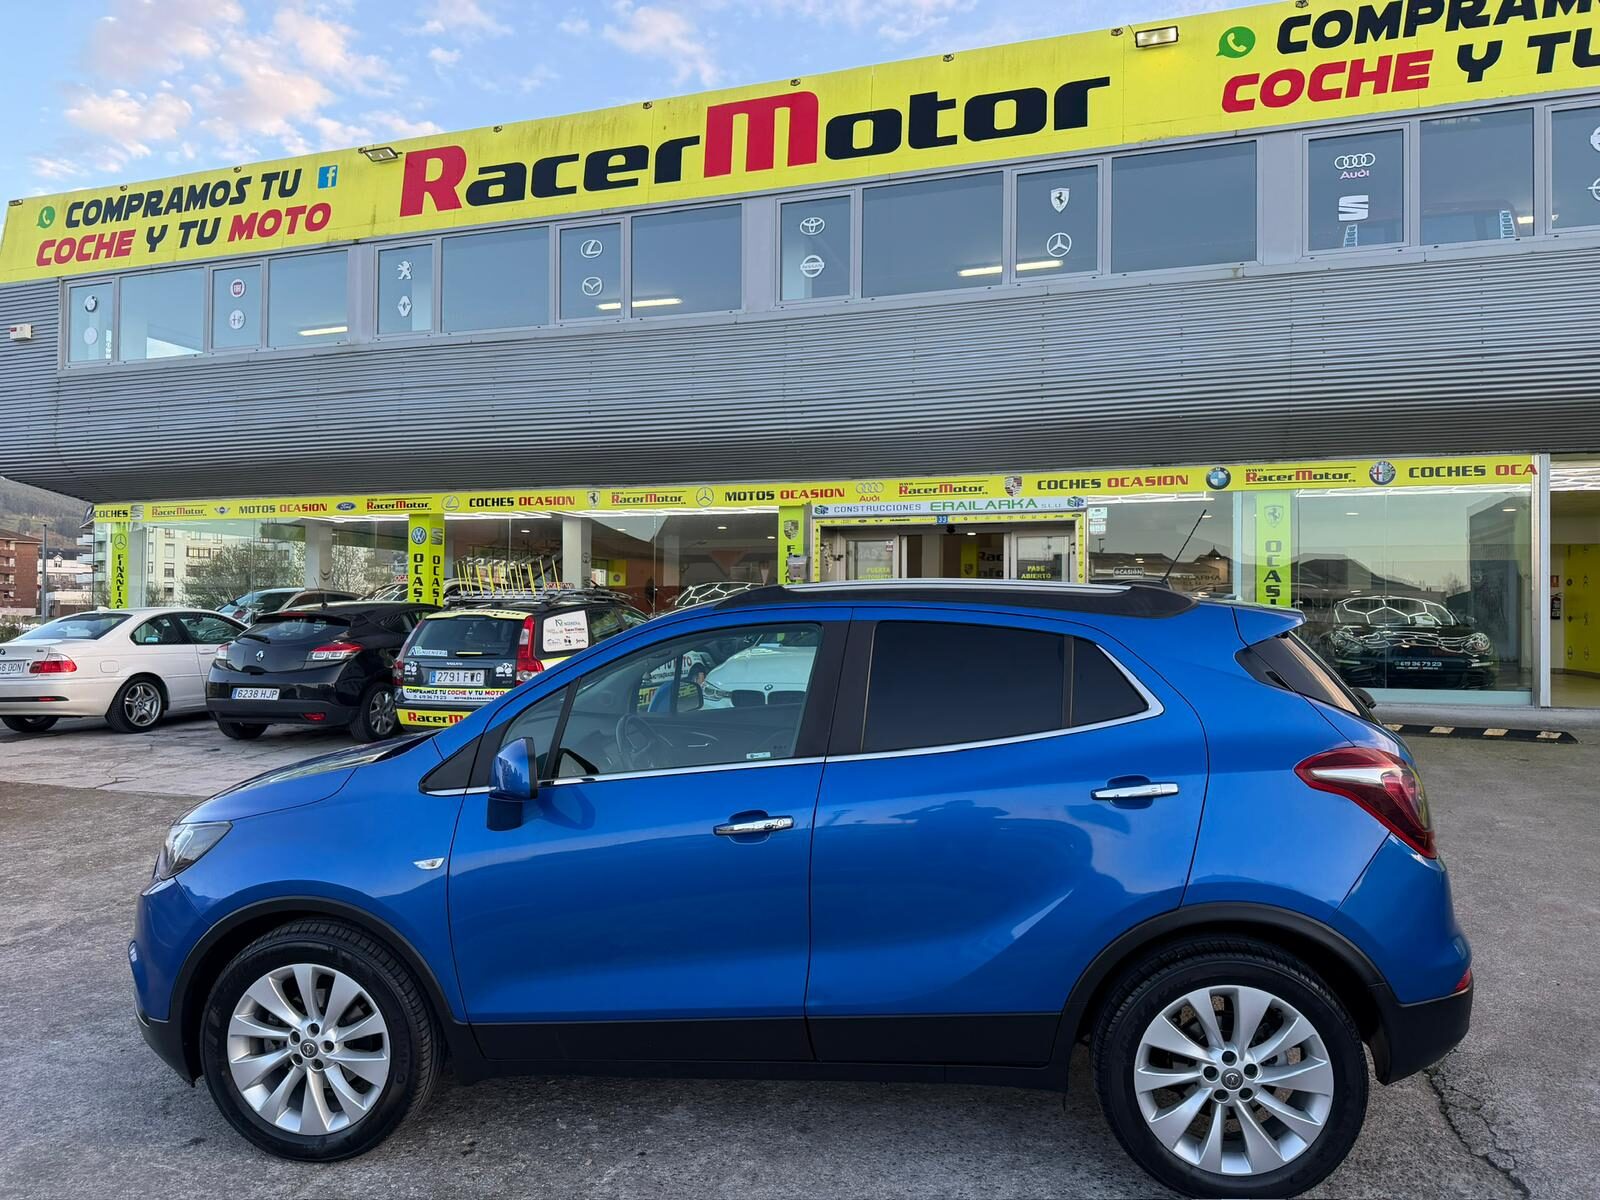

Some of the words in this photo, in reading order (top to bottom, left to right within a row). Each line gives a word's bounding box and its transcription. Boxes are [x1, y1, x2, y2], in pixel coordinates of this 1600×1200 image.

[1221, 49, 1434, 113] COCHE
[1457, 40, 1503, 83] Y
[399, 76, 1110, 217] RacerMotor
[1339, 168, 1370, 180] Audi
[65, 175, 252, 229] COMPRAMOS
[261, 168, 303, 201] TU
[36, 229, 137, 266] COCHE
[146, 224, 168, 253] Y
[178, 217, 222, 249] TU
[227, 202, 332, 243] MOTO
[1245, 470, 1352, 482] RacerMotor
[1408, 465, 1486, 478] COCHES
[1495, 463, 1538, 476] OCA
[1037, 478, 1102, 490] COCHES
[1107, 474, 1189, 488] OCASION
[725, 490, 775, 502] MOTOS
[779, 488, 845, 500] OCASION
[899, 483, 985, 495] RacerMotor
[469, 496, 514, 508] COCHES
[518, 495, 576, 506] OCASION
[611, 493, 682, 504] RacerMotor
[238, 504, 276, 514] MOTOS
[279, 503, 328, 513] OCASION
[366, 499, 429, 511] RacerMotor
[834, 503, 921, 513] CONSTRUCCIONES
[929, 498, 1038, 511] ERAILARKA
[94, 509, 129, 519] COCHES
[152, 507, 204, 517] RacerMotor
[938, 515, 948, 523] 33
[437, 671, 460, 682] 2791
[237, 689, 259, 698] 6238
[260, 689, 277, 698] HJP
[406, 687, 438, 695] COMPRAMOS
